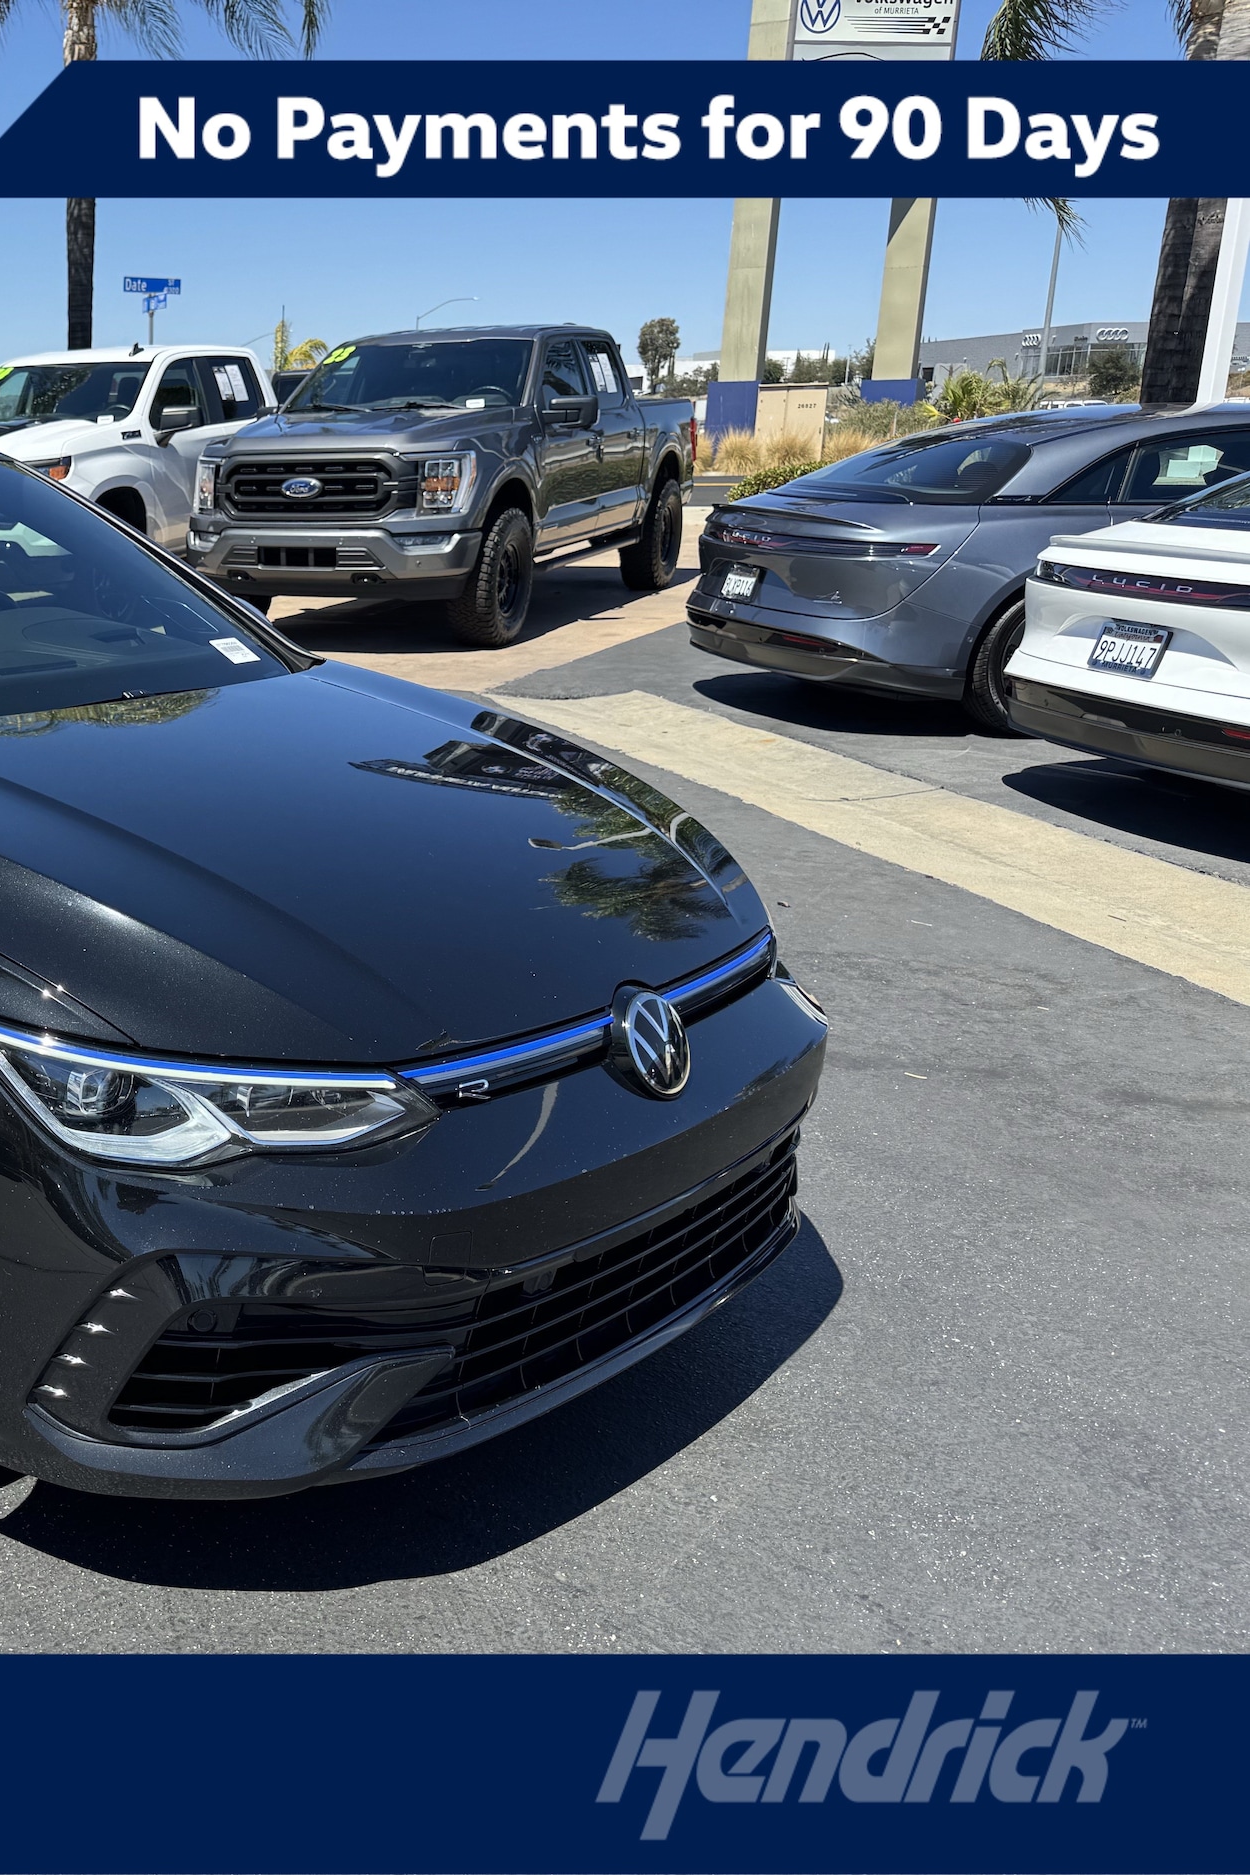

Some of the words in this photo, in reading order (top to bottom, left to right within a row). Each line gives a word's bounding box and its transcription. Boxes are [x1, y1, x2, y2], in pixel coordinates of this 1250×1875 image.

[883, 7, 919, 15] MURRIETA
[125, 278, 147, 292] Date
[1092, 574, 1193, 594] LUCID
[1116, 624, 1158, 635] VOLKSWAGEN
[1095, 640, 1157, 669] 9PJJ147
[1101, 660, 1137, 673] MURRIETA
